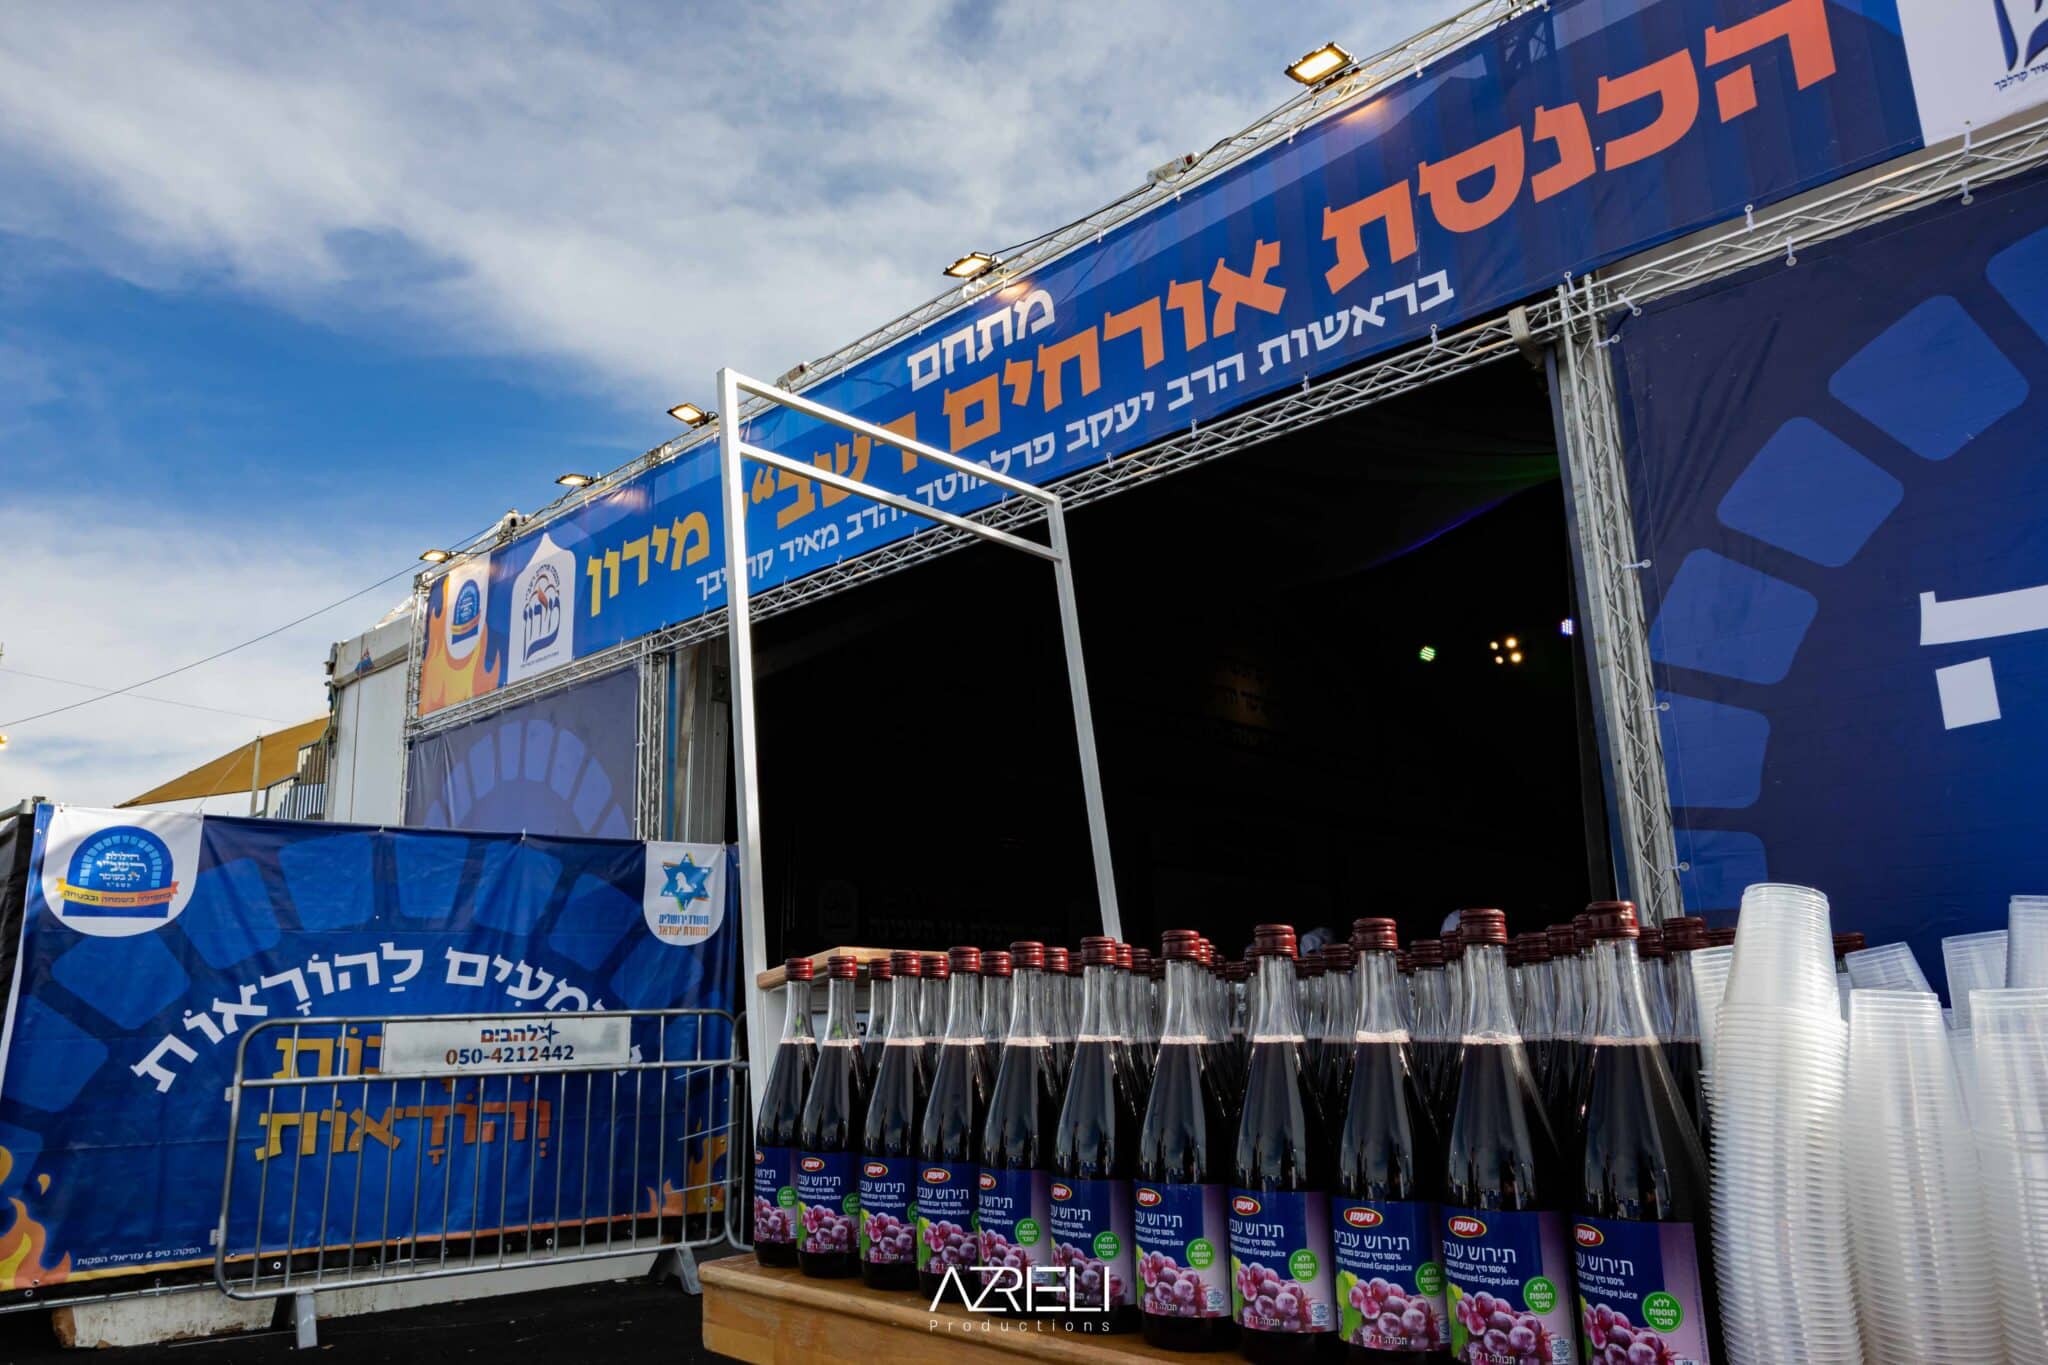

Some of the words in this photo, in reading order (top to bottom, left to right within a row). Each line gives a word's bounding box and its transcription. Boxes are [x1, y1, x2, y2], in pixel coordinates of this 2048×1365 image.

[1322, 0, 1836, 295] הכנסת
[1258, 269, 1454, 375] בראשות
[907, 289, 1055, 392] מתחם
[943, 239, 1286, 454] אורחים
[1166, 352, 1245, 411] הרב
[1066, 391, 1155, 452] יעקב
[780, 522, 839, 562] מאיר
[586, 511, 710, 618] מירון
[445, 1045, 575, 1065] 050-4212442
[936, 1188, 969, 1199] תירוש
[985, 1196, 1013, 1209] תירוש
[1060, 1207, 1091, 1221] תירוש
[1147, 1214, 1183, 1228] תירוש
[1245, 1222, 1284, 1238] תירוש
[1453, 1219, 1478, 1232] טעמן
[1363, 1235, 1410, 1251] תירוש
[1467, 1245, 1517, 1264] תירוש
[1588, 1255, 1634, 1277] תירוש
[1619, 1289, 1638, 1300] Juice
[1653, 1298, 1670, 1307] ללא
[1649, 1308, 1677, 1317] תוספת
[1654, 1317, 1674, 1326] סוכר
